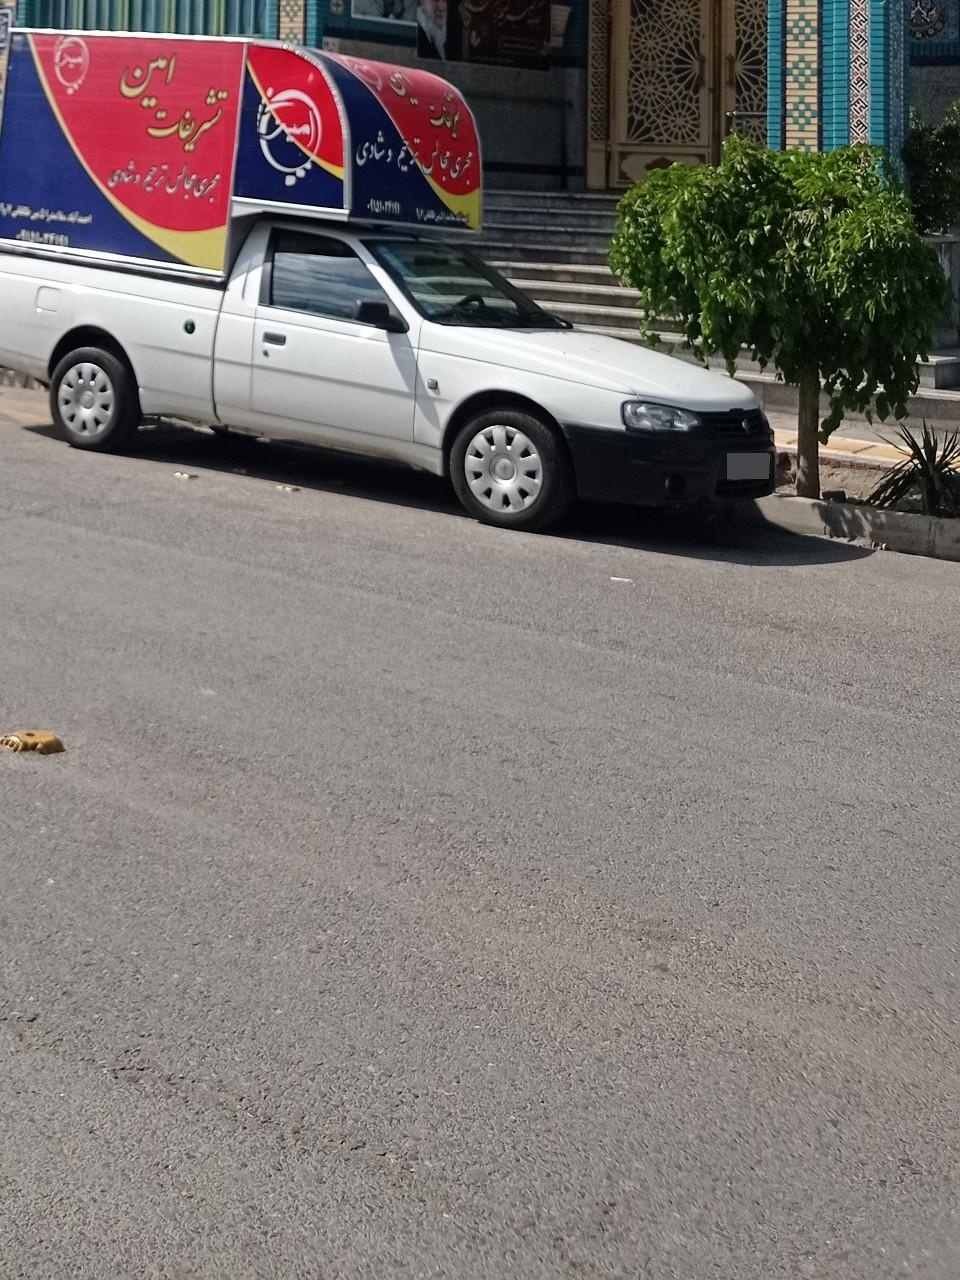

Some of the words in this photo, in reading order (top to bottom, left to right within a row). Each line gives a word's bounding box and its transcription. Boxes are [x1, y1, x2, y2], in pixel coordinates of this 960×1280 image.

[119, 53, 177, 108] امین
[146, 87, 230, 152] تشریفات
[355, 129, 386, 166] شادی
